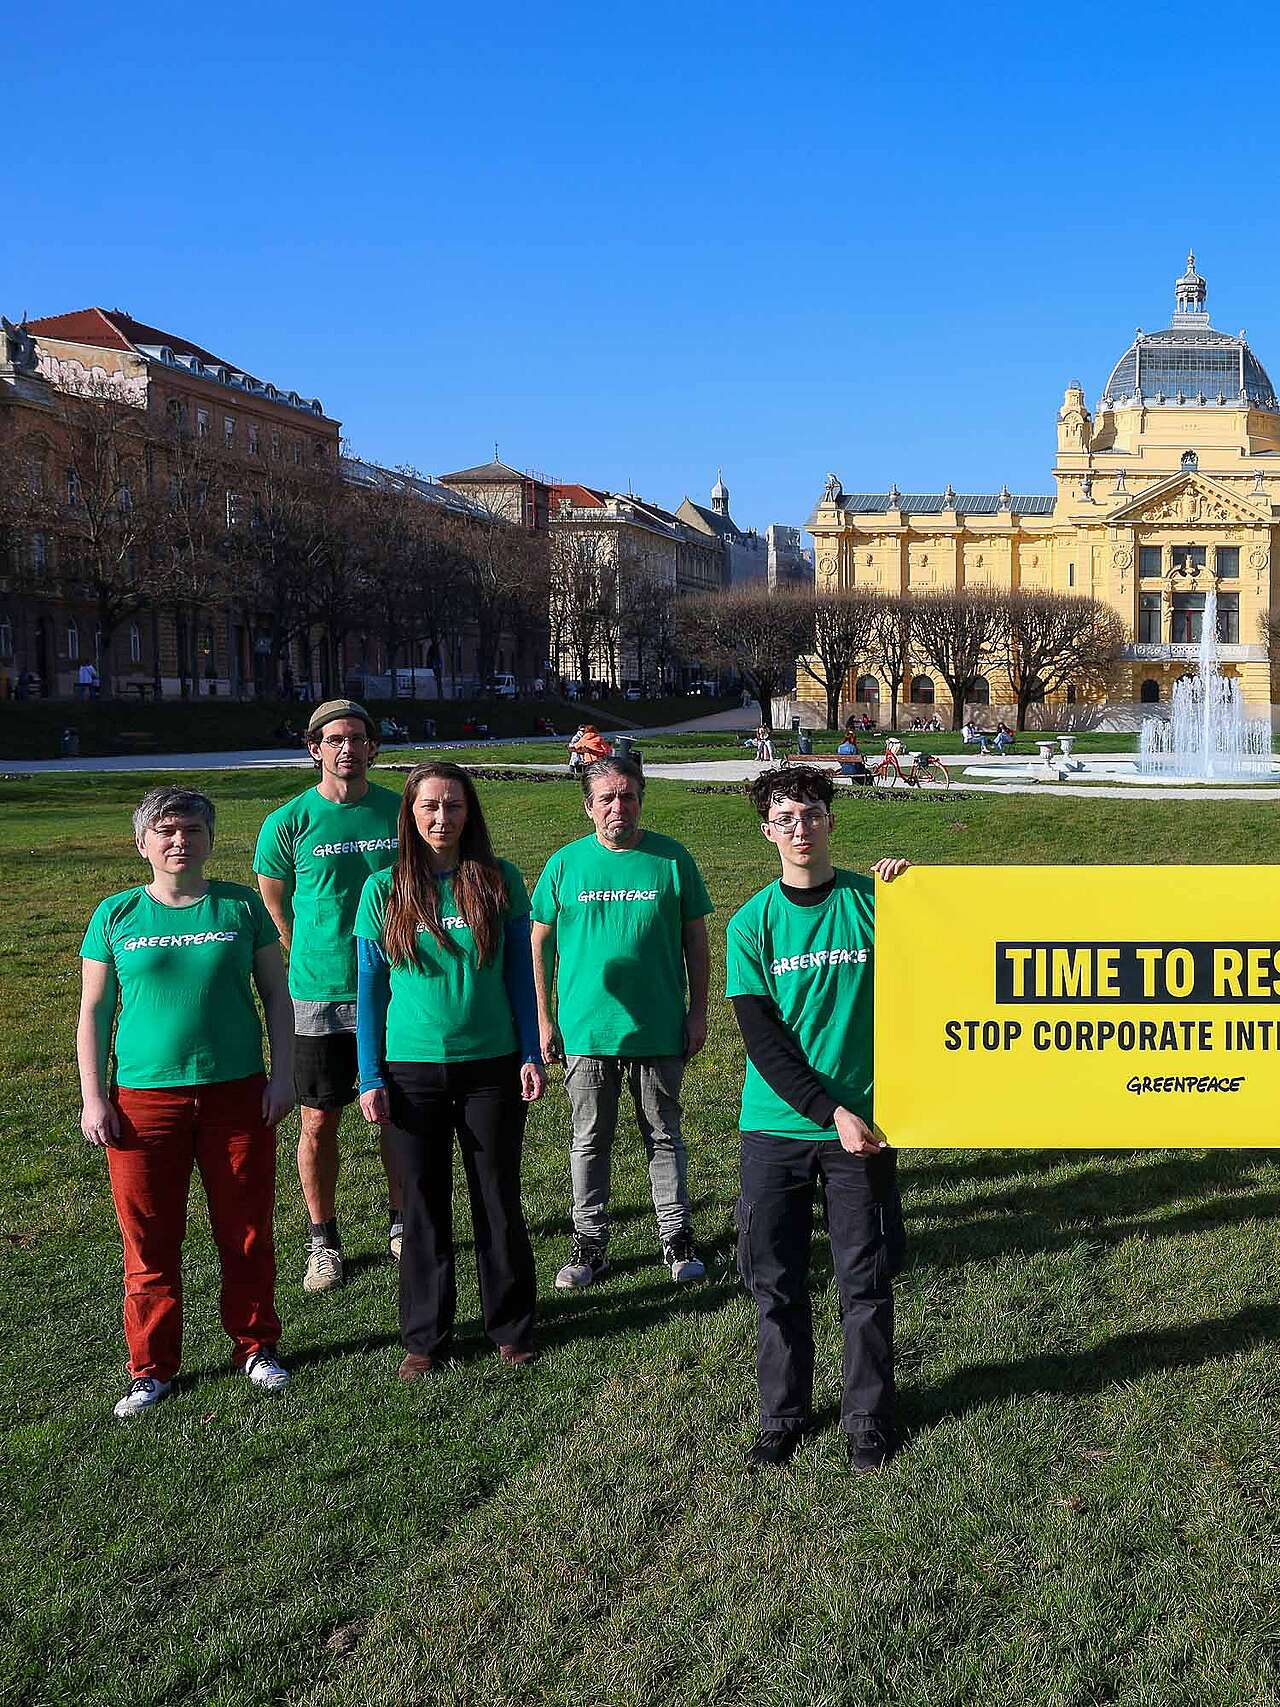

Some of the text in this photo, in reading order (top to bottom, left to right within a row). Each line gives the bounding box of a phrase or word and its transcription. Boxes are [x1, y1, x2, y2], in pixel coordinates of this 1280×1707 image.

[312, 838, 399, 858] GREENPEACE
[577, 888, 660, 904] GREENPEACE
[123, 931, 238, 952] GREENPEACE
[769, 948, 868, 976] GREENPEACE
[1005, 948, 1121, 997] TIME
[1136, 947, 1195, 998] TO
[944, 1020, 1022, 1051] STOP
[1033, 1020, 1213, 1051] CORPORATE
[1126, 1075, 1246, 1095] GREENPEACE
